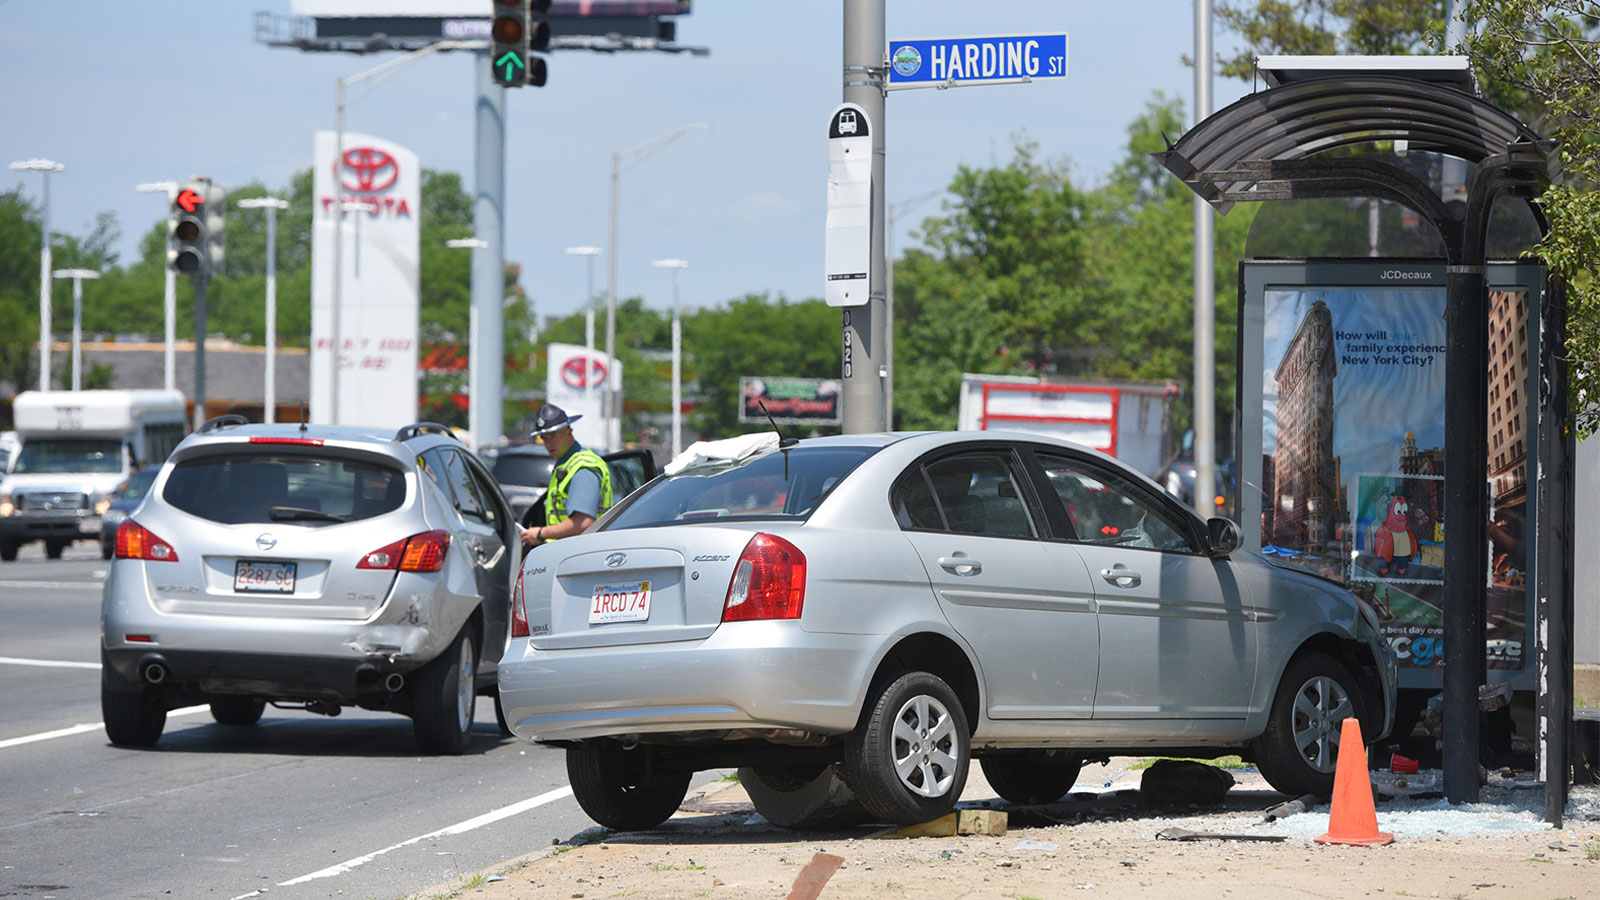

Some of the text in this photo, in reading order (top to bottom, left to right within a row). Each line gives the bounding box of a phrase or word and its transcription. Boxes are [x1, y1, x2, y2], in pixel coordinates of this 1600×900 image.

[930, 40, 1040, 79] HARDING
[1048, 56, 1064, 75] ST
[1380, 270, 1432, 280] JCDecaux
[1335, 330, 1417, 343] How will your
[1346, 342, 1446, 355] family experienc
[1342, 355, 1435, 367] New York City?
[238, 568, 293, 586] 2287 SC
[593, 591, 647, 613] 1RCD 74
[1387, 625, 1408, 634] best
[1408, 626, 1426, 635] day
[1426, 627, 1445, 635] eve
